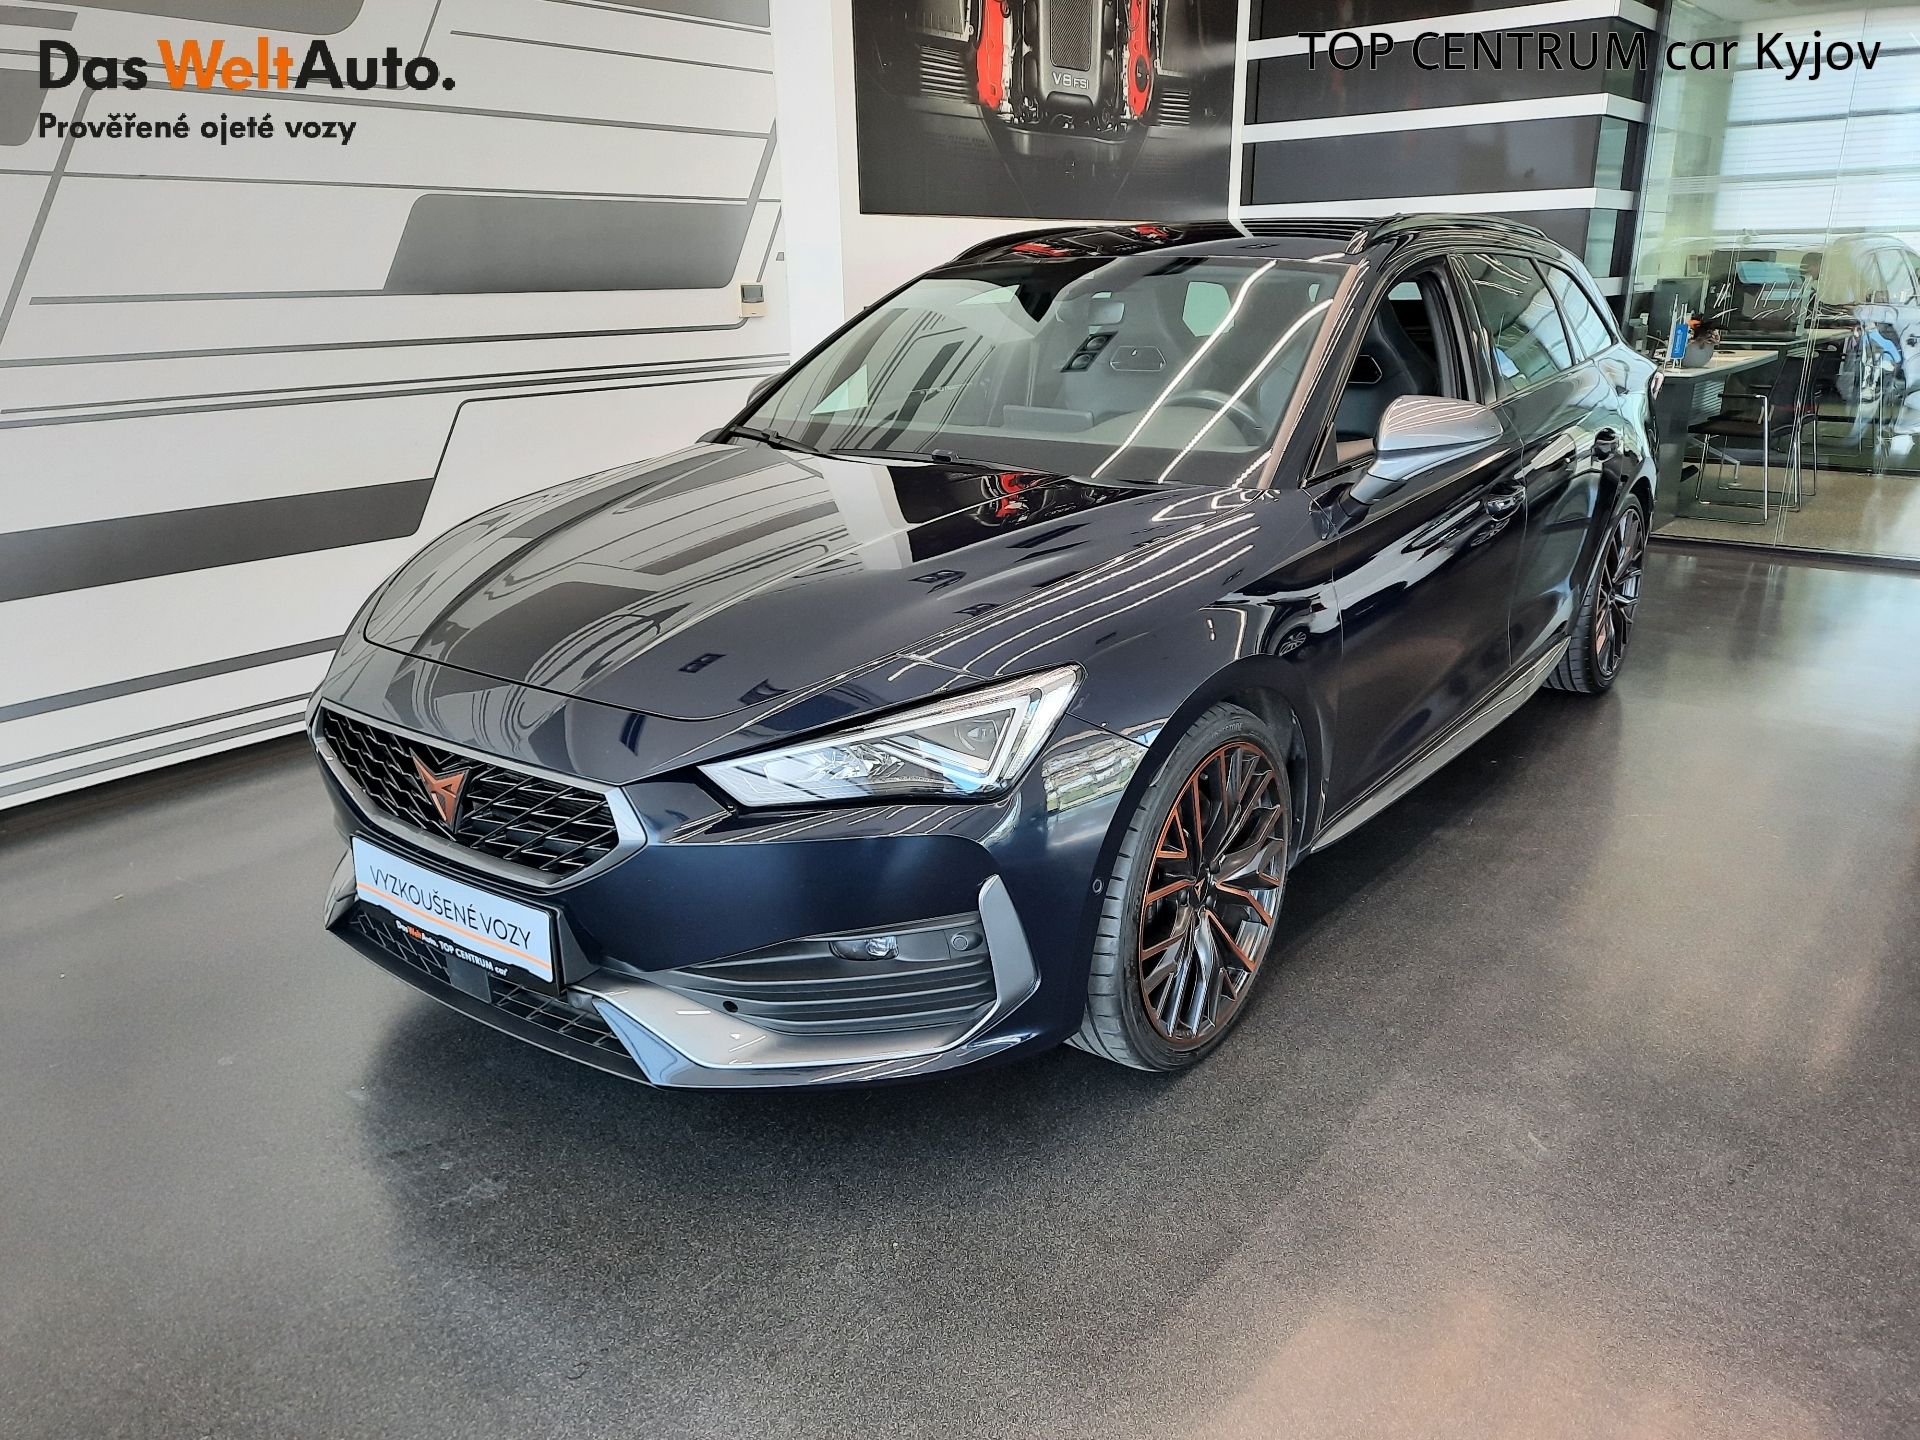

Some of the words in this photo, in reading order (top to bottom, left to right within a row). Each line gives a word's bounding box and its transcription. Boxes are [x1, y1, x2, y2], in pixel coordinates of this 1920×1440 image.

[369, 865, 479, 931] VYZKOUŠENÉ
[480, 912, 531, 950] VOZY
[438, 940, 455, 955] TOP
[455, 948, 494, 972] CENTRUM
